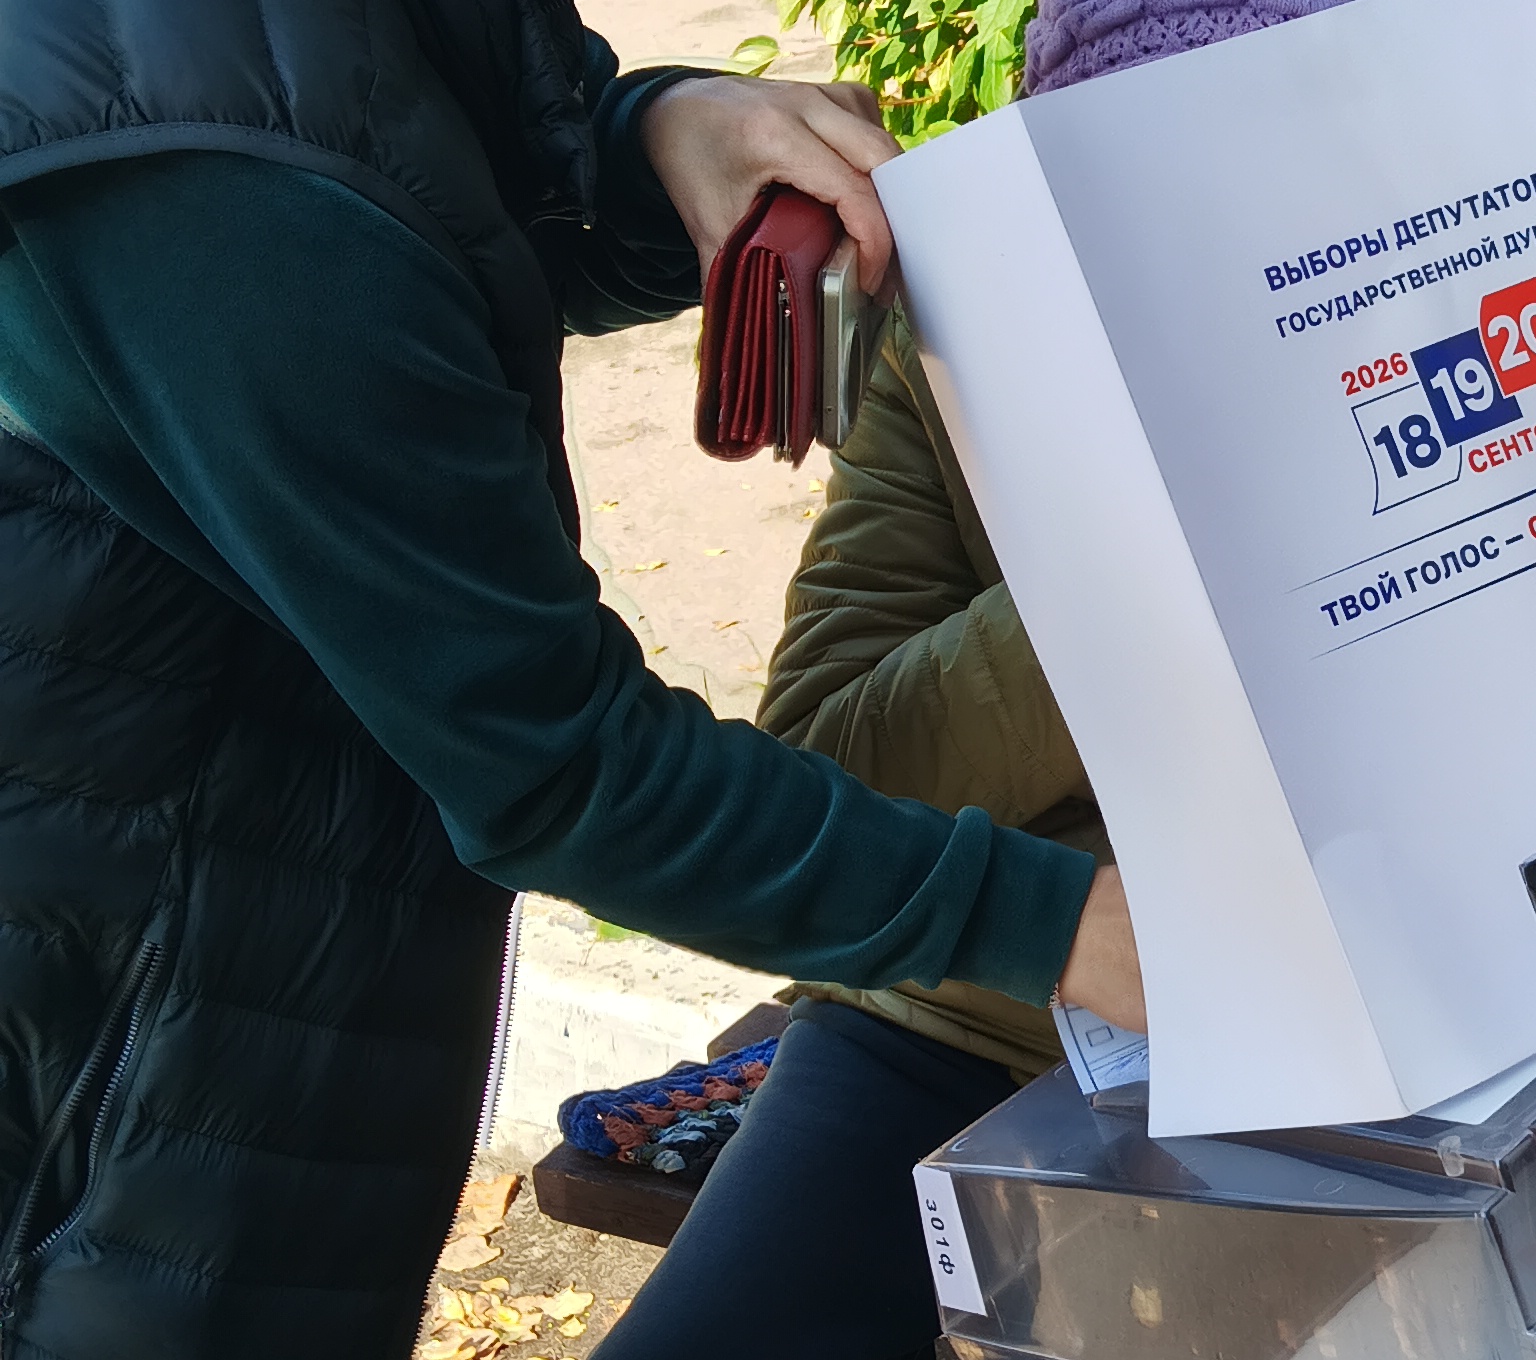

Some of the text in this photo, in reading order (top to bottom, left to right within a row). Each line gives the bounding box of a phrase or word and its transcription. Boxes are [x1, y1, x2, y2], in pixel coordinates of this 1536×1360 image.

[1263, 228, 1389, 292] ВЫБОРЫ
[1275, 236, 1501, 339] ГОСУДАРСТВЕННОЙ
[1341, 353, 1409, 395] 2026
[1374, 413, 1442, 478] 18
[1430, 358, 1494, 422] 19
[1320, 570, 1402, 627] ТВОЙ
[1405, 536, 1500, 593] ГОЛОС
